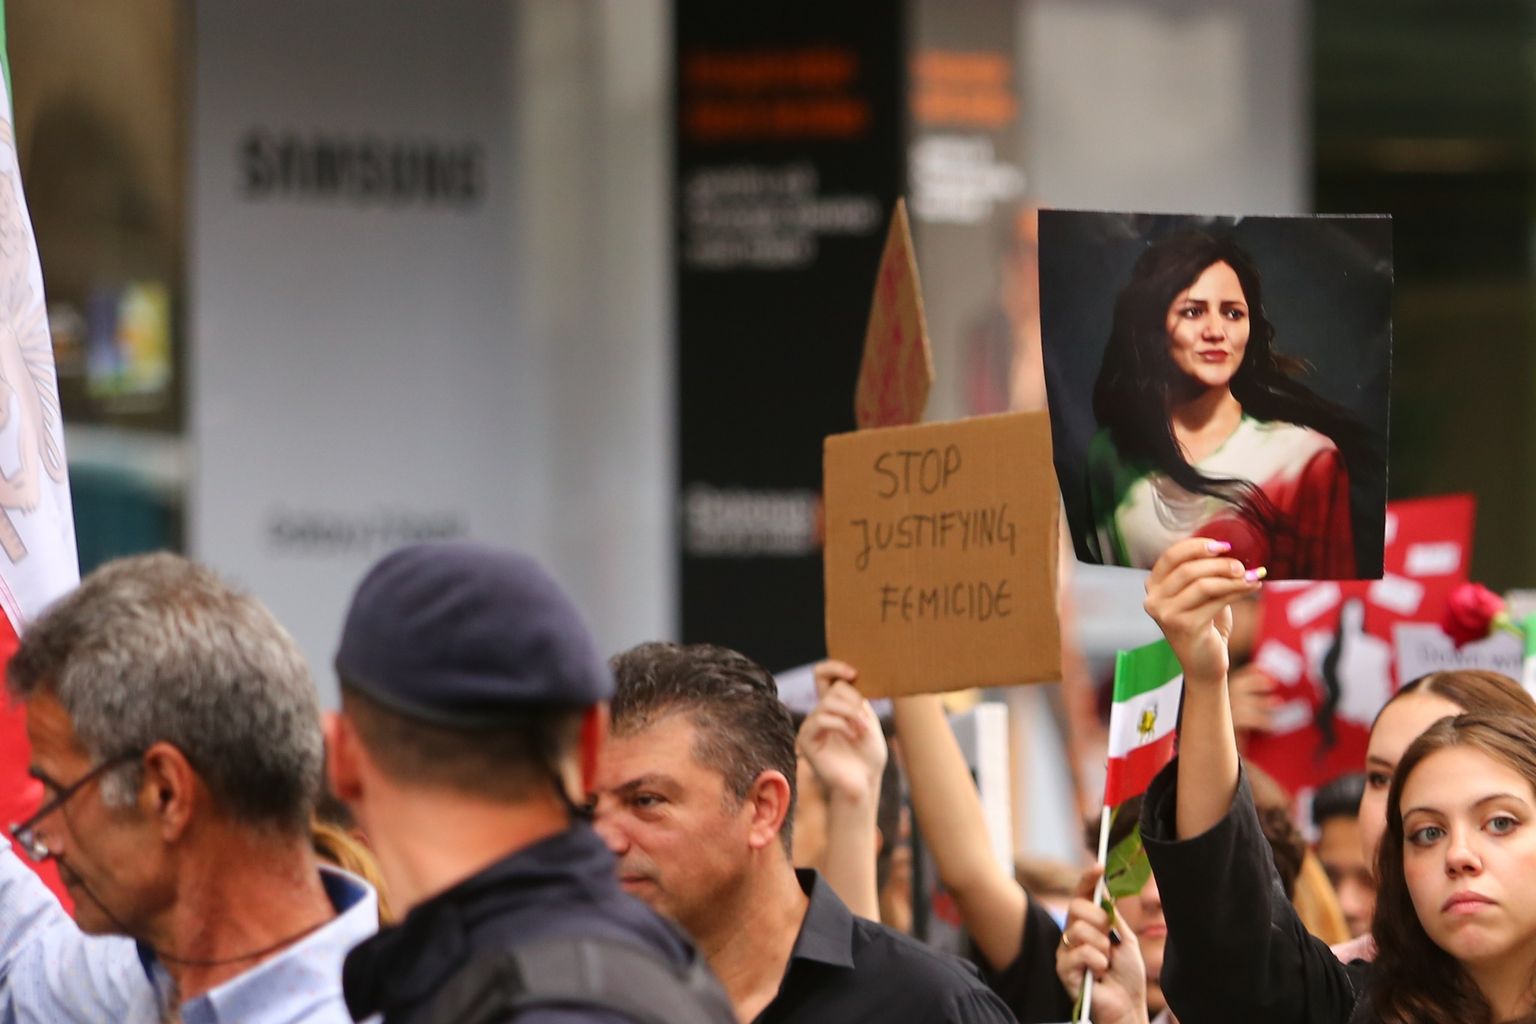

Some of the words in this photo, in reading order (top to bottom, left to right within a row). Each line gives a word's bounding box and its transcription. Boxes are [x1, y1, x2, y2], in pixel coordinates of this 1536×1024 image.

[239, 131, 486, 205] SAMSUNG
[873, 444, 962, 499] STOP
[850, 504, 1017, 572] JUSTIFYING
[880, 580, 1013, 623] FEMICIDE
